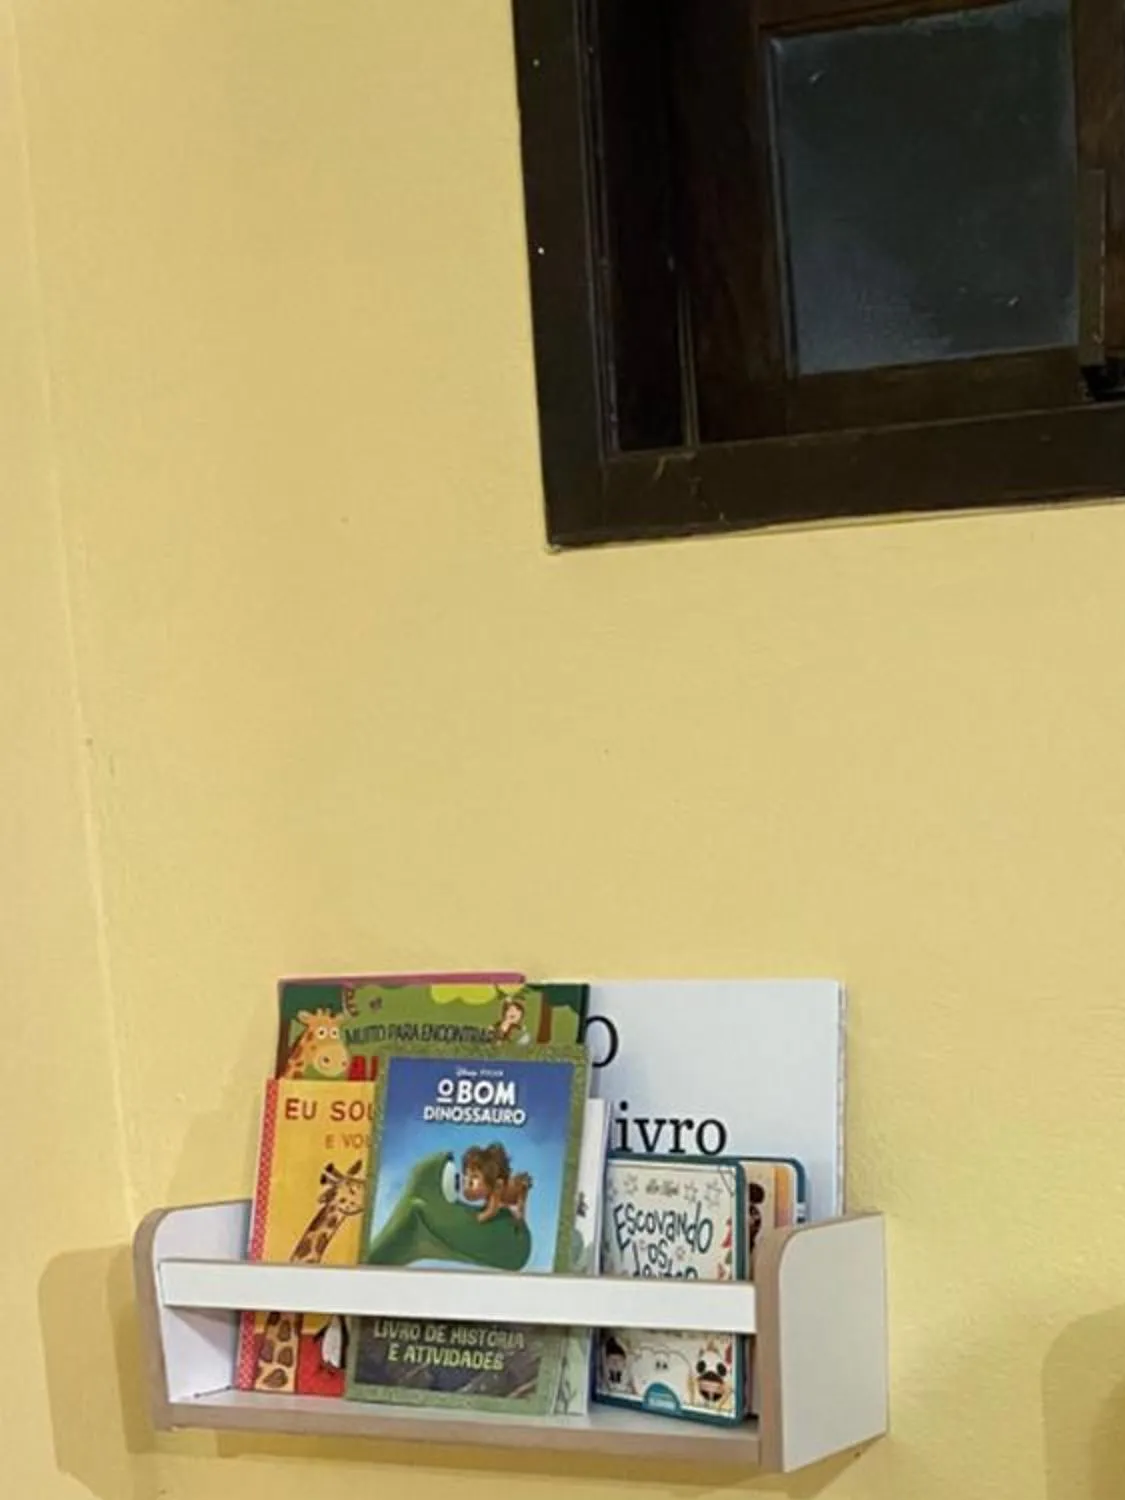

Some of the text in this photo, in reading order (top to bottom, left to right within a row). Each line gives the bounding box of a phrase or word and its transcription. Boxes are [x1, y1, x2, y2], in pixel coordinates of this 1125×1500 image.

[438, 1079, 516, 1106] O BOM
[284, 1098, 318, 1121] EU
[423, 1105, 526, 1126] DINOSSAURO
[614, 1100, 728, 1156] ivro
[613, 1200, 714, 1255] Escovando
[374, 1319, 525, 1349] LIVRO DE HISTÓRIA
[388, 1343, 505, 1370] E ATIVIDADES
